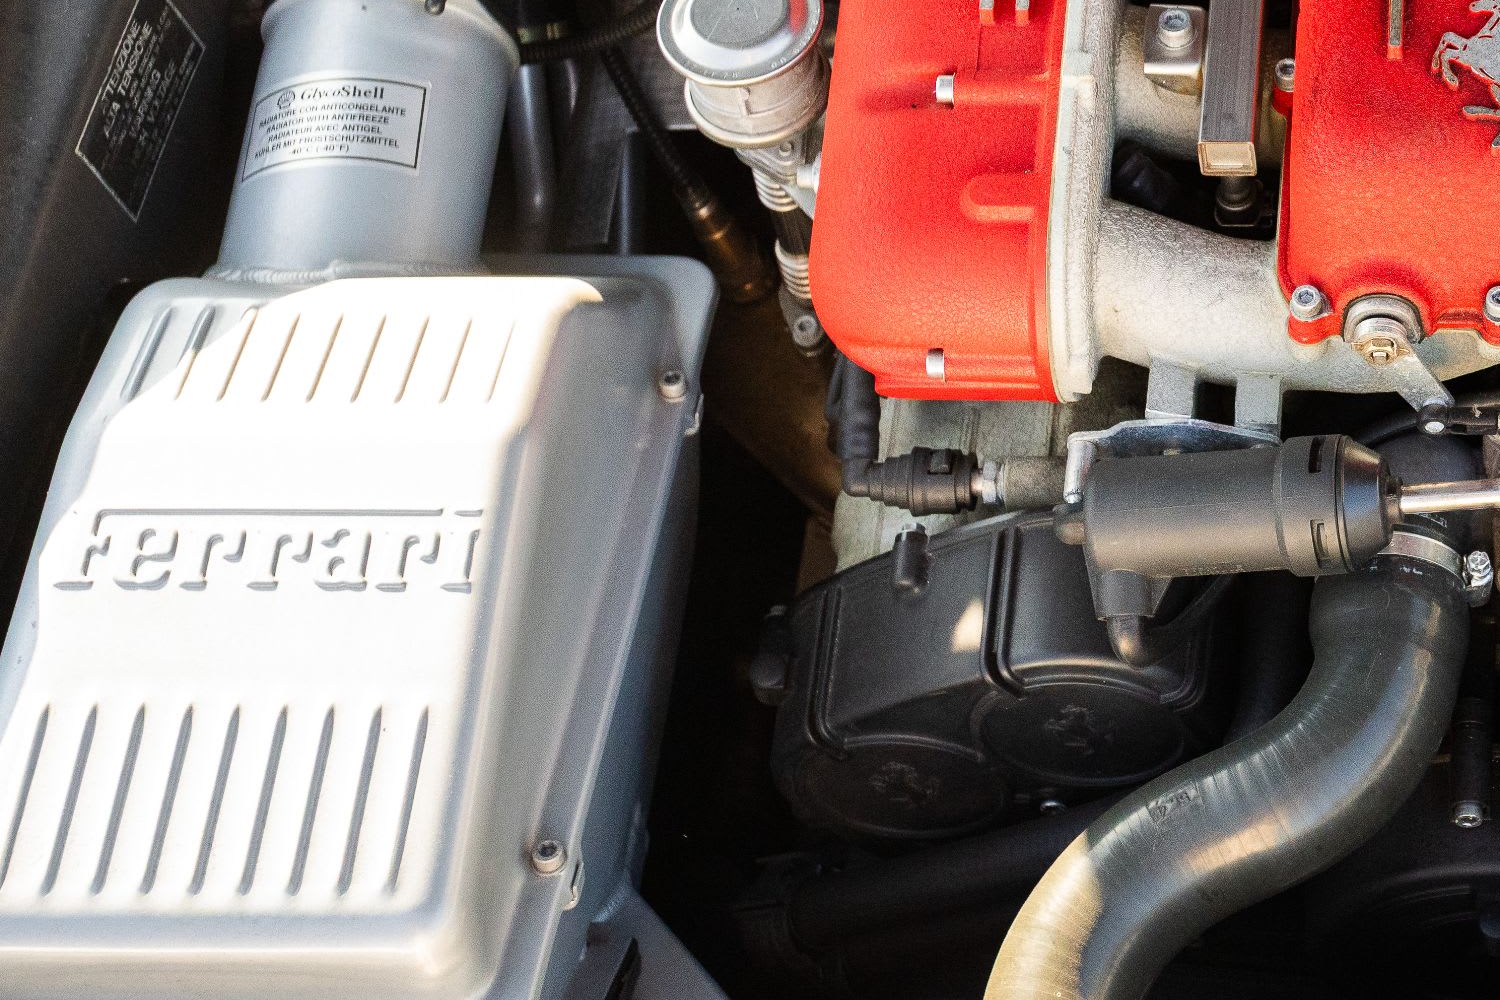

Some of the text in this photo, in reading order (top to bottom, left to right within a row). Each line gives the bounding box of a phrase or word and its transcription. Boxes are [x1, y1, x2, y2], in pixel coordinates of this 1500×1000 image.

[117, 21, 151, 97] TENSIONE
[300, 85, 385, 102] GlycoShell
[259, 108, 297, 129] RADIATORE
[319, 101, 407, 116] ANTICONGELANTE
[266, 113, 390, 134] RADIATOR WITH ANTIFREEZE
[341, 123, 383, 135] ANTIGEL
[299, 133, 400, 149] FROSTSCHUTZMITTEL
[53, 507, 484, 594] Ferrari
